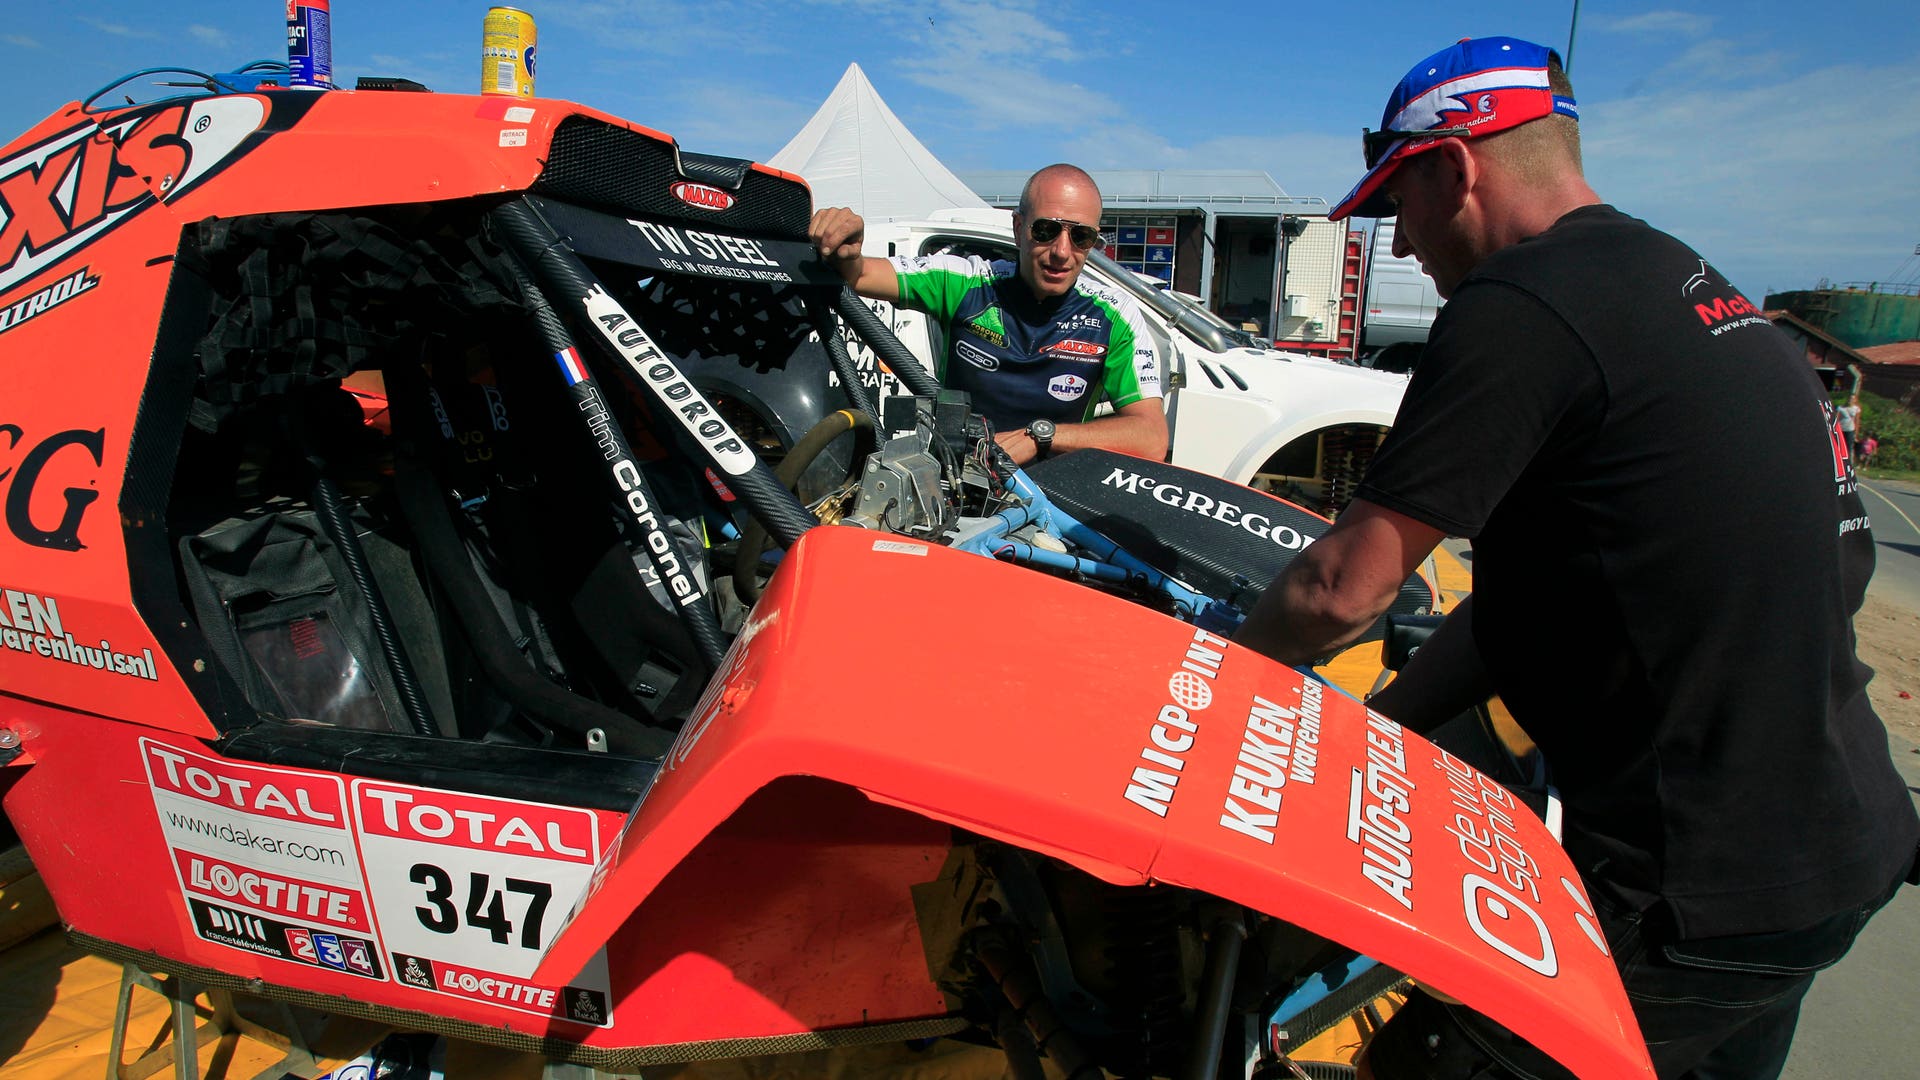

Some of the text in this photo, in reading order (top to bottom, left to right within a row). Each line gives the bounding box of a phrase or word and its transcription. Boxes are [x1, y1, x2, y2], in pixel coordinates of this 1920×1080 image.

[683, 184, 729, 210] MAXXIS
[626, 218, 780, 267] TW STEEL
[659, 257, 793, 282] BIG IN OVERSIZED WATCHES
[959, 343, 994, 368] COSO
[1053, 340, 1098, 355] MAXXIS
[598, 313, 744, 455] AUTODROP
[1051, 384, 1085, 394] eurol
[578, 387, 622, 460] Tim
[612, 458, 702, 607] Coronel
[150, 746, 335, 822] TOTAL
[1219, 694, 1296, 844] KEUKEN
[167, 809, 346, 867] www.dakar.com
[365, 787, 588, 858] TOTAL
[1444, 812, 1498, 873] de
[190, 858, 352, 922] LOCTITE
[409, 862, 553, 951] 347
[294, 937, 317, 958] 2
[320, 942, 343, 964] 3
[350, 948, 373, 971] 4
[405, 973, 432, 988] DAKAR
[443, 969, 555, 1008] LOCTITE
[573, 1009, 601, 1022] DAKAR
